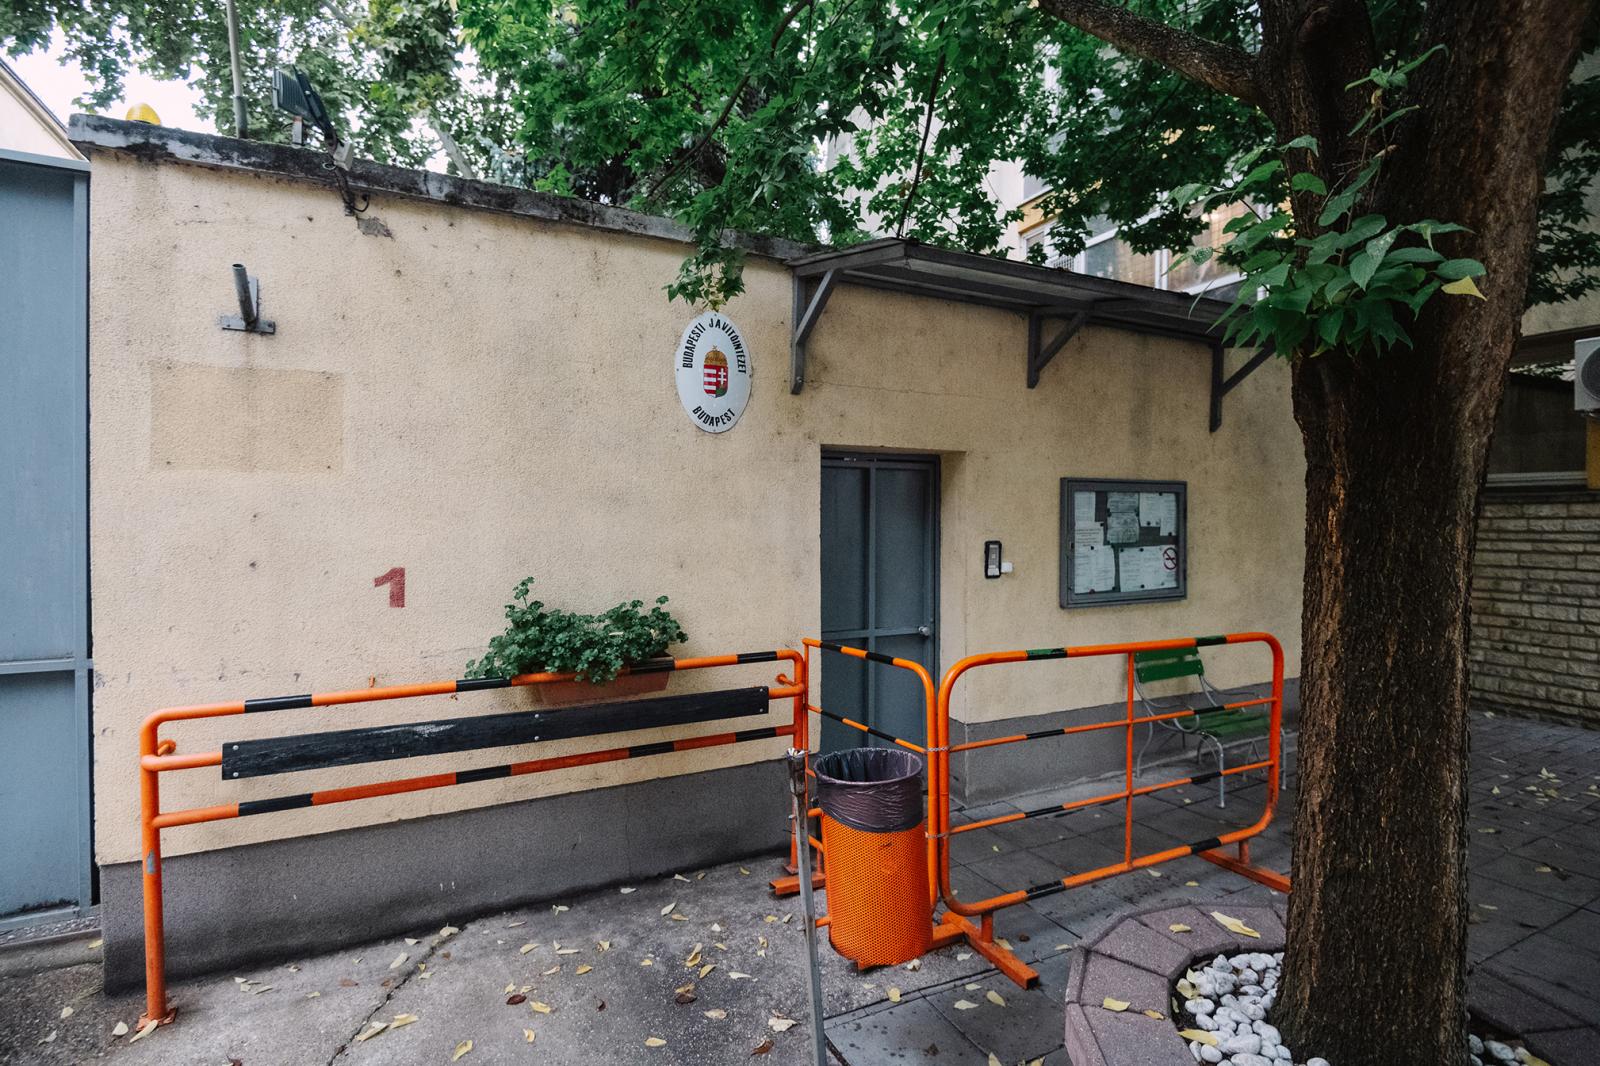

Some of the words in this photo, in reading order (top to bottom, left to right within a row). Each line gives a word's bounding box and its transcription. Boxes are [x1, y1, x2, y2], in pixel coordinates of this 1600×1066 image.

[683, 323, 706, 368] BUDAPESTI
[692, 405, 736, 427] BUDAPEST
[374, 567, 405, 608] 1
